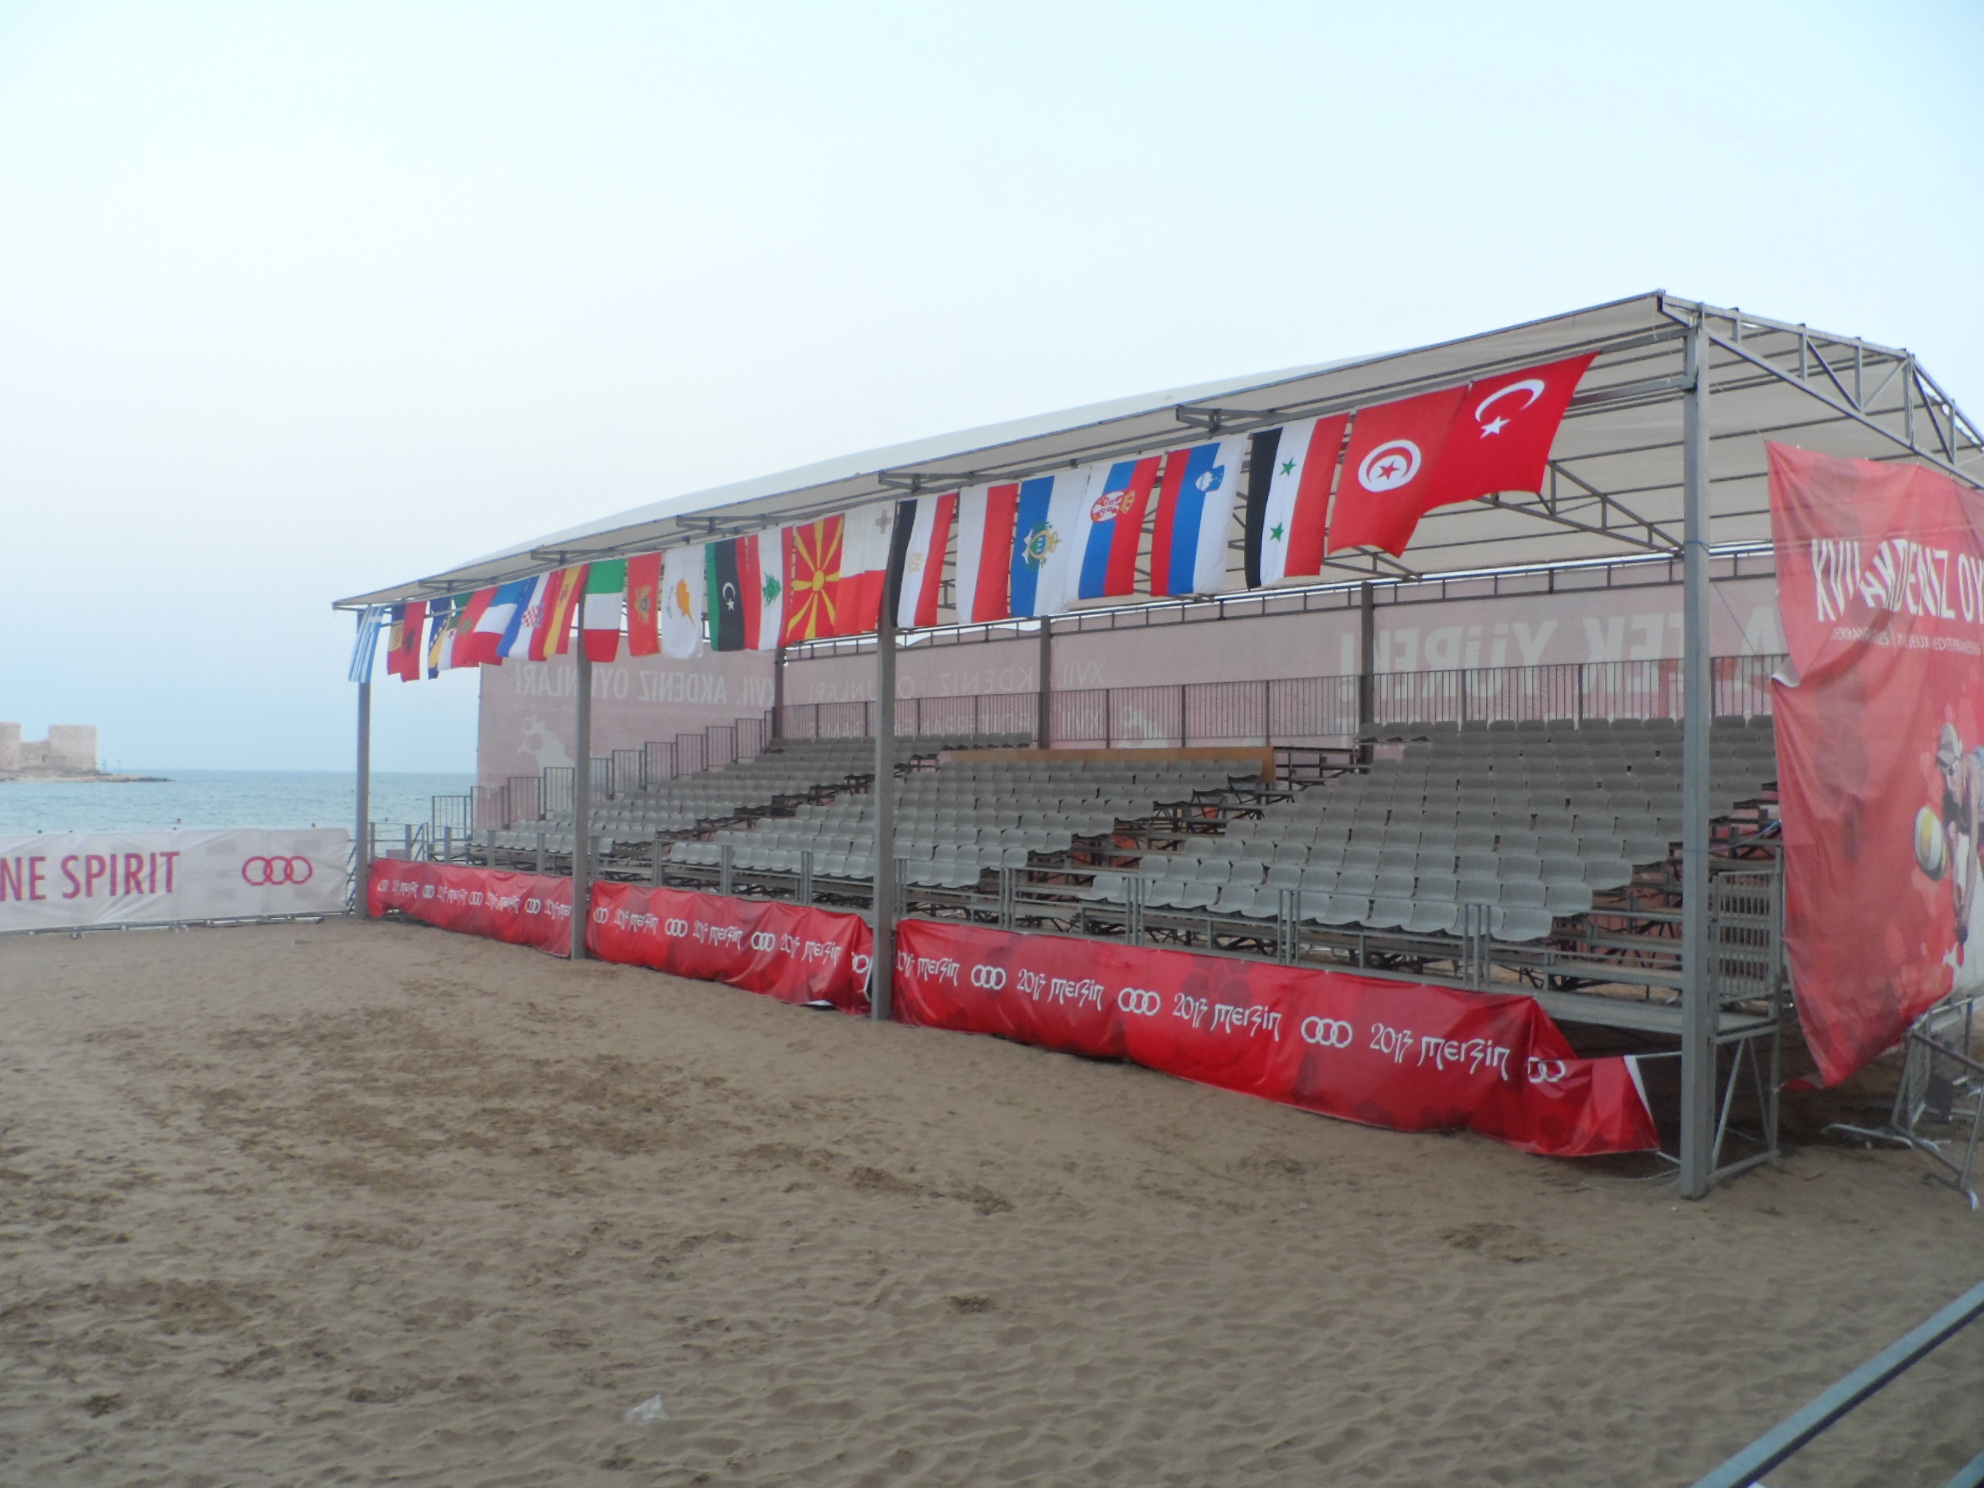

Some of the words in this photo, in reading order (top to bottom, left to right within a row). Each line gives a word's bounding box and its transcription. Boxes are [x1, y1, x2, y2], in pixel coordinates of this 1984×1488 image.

[60, 851, 181, 900] SPIRIT
[1172, 992, 1209, 1029] 2013
[1370, 1022, 1414, 1063] 2013
